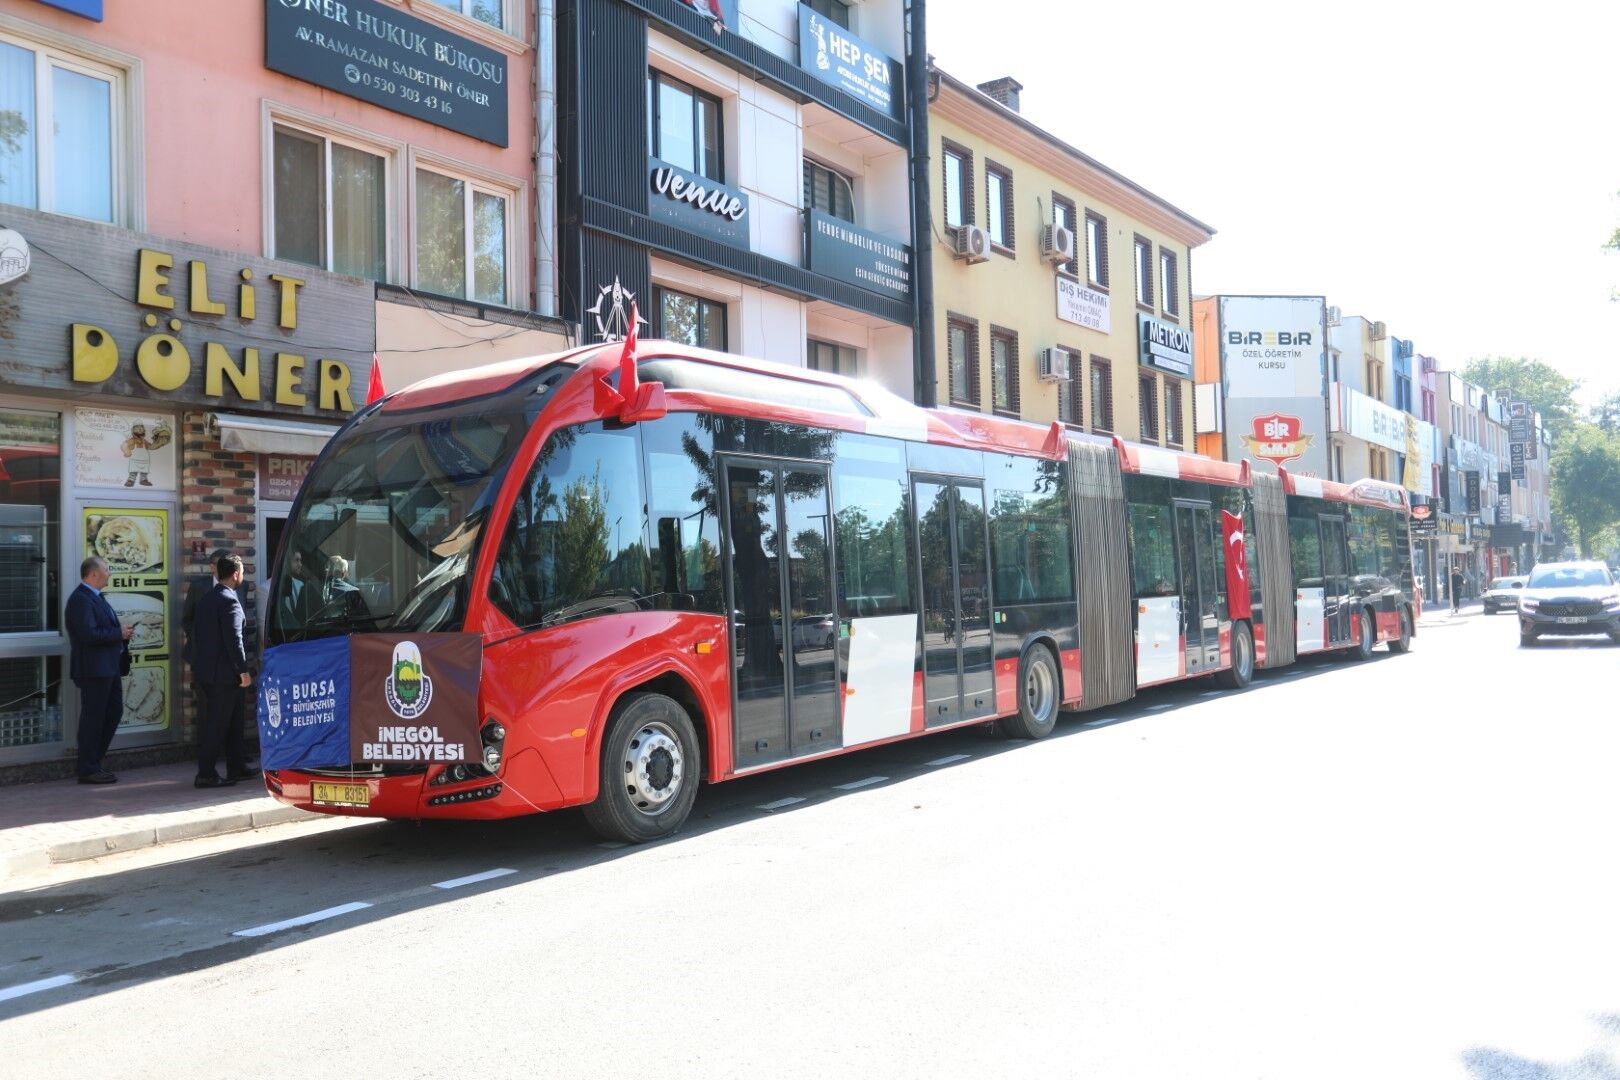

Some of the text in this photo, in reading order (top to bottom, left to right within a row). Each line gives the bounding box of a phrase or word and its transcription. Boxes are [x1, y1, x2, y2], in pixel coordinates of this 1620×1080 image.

[356, 10, 428, 56] HUKUK
[434, 42, 503, 84] BÜROSU
[829, 31, 861, 66] HEP
[863, 52, 890, 84] ŞEN
[392, 61, 453, 94] SADETTİN
[457, 82, 490, 107] ÖNER
[363, 73, 453, 114] 0 530 303 43 16
[1077, 287, 1107, 308] HEKİMİ
[1149, 320, 1191, 354] METRON
[1242, 348, 1302, 358] ÖZEL ÖĞRETİM
[71, 313, 355, 412] DÖNER
[1258, 361, 1286, 369] KURSU
[269, 458, 315, 476] PAK
[113, 575, 140, 587] ELİT
[292, 679, 335, 700] BURSA
[293, 697, 336, 713] BÜYÜKŞEHİR
[293, 710, 335, 727] BELEDİYESİ
[378, 726, 444, 743] İNEGÖL
[362, 743, 465, 760] BELEDİYESİ
[318, 785, 328, 799] 34
